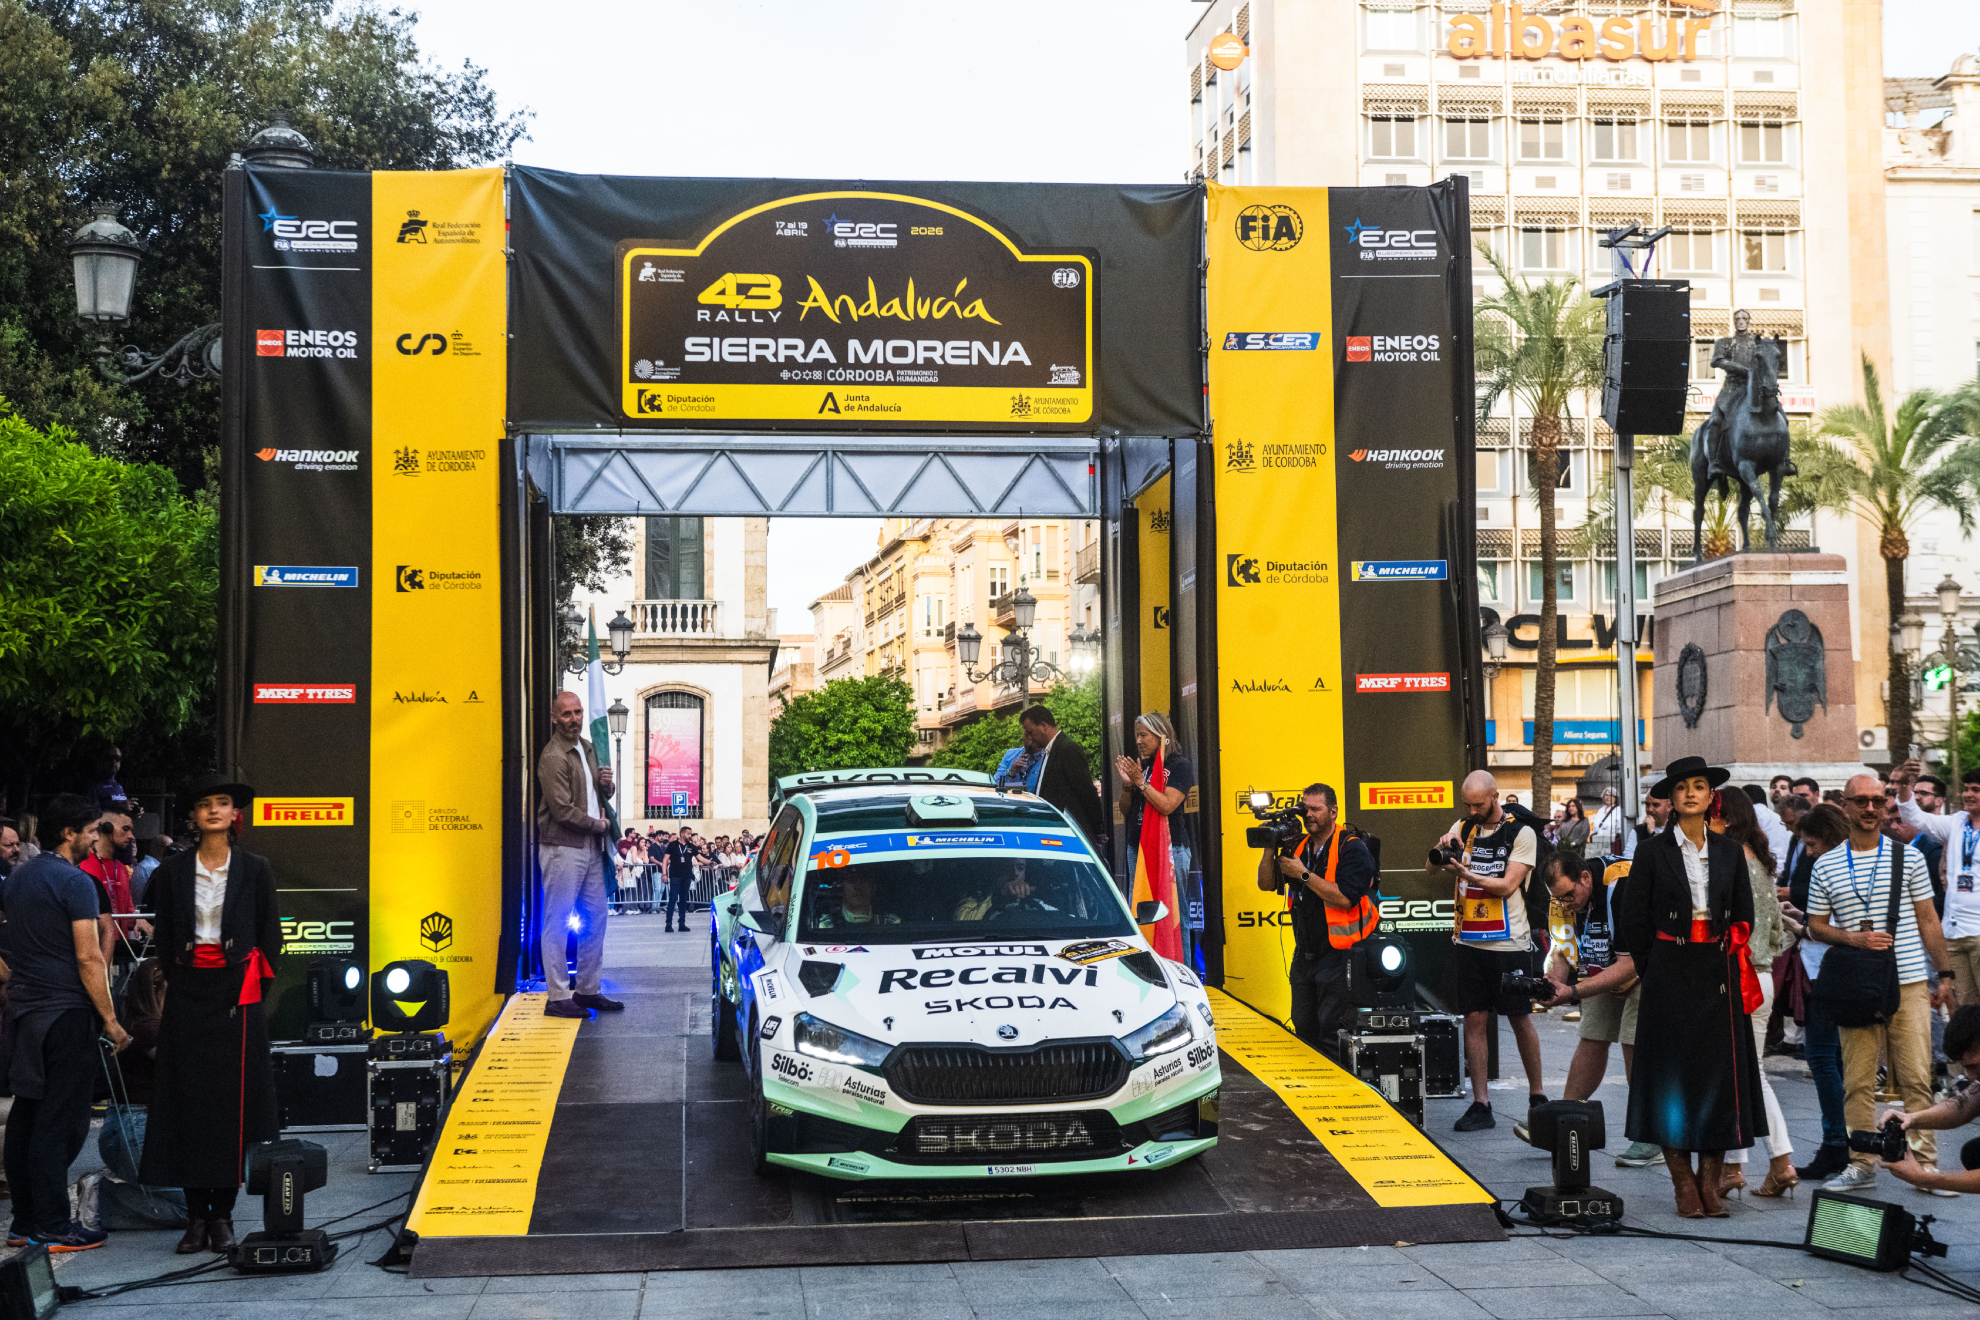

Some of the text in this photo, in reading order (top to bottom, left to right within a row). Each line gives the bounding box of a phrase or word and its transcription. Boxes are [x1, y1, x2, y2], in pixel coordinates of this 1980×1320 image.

[1447, 2, 1713, 60] albasur
[1513, 65, 1648, 86] inmobiliarias
[273, 220, 358, 239] ERC
[447, 221, 481, 229] Federación
[776, 221, 808, 230] 17 al 19
[834, 222, 898, 238] ERC
[1240, 215, 1297, 241] FIA
[438, 230, 466, 238] Española
[776, 229, 808, 237] ABRIL
[910, 227, 944, 236] 2026
[432, 237, 480, 245] Automovilismo
[1359, 230, 1437, 247] ERC
[1054, 271, 1078, 285] FIA
[698, 272, 783, 310] 43
[796, 276, 1003, 326] Andalucía
[697, 310, 782, 323] RALLY
[286, 330, 358, 346] ENEOS
[1373, 334, 1440, 350] ENEOS
[286, 347, 358, 359] MOTOR OIL
[684, 336, 1032, 367] SIERRA MORENA
[1374, 352, 1440, 362] MOTOR OIL
[826, 367, 895, 382] CÓRDOBA
[667, 394, 715, 404] Diputación
[844, 394, 870, 402] Junta
[1034, 397, 1078, 406] AYUNTAMIENTO
[667, 404, 716, 412] de Córdoba
[844, 403, 902, 412] de Andalucía
[1034, 407, 1042, 415] DE
[426, 450, 486, 460] AYUNTAMIENTO
[1262, 444, 1327, 456] AYUNTAMIENTO
[294, 462, 358, 472] driving emotion
[426, 461, 436, 472] DE
[1262, 456, 1273, 468] DE
[1385, 462, 1411, 470] driving
[1266, 560, 1328, 572] Diputación
[1378, 566, 1439, 575] MICHELIN
[283, 572, 349, 581] MICHELIN
[429, 570, 482, 580] Diputación
[1266, 573, 1329, 584] de Córdoba
[429, 581, 482, 590] de Córdoba
[1231, 678, 1293, 694] Andalucía
[1358, 676, 1448, 689] MRF TYRES
[256, 688, 353, 699] MRF TYRES
[392, 690, 449, 704] Andalucía
[1564, 731, 1608, 740] Allianz Seguros
[676, 795, 683, 804] P
[1368, 786, 1446, 805] PIRELLI
[263, 802, 345, 821] PIRELLI
[428, 823, 440, 831] DE
[810, 849, 851, 870] 10
[1237, 910, 1293, 928] SKO
[921, 946, 1043, 958] MOTUL
[878, 964, 1099, 994] Recalvi
[766, 978, 777, 1000] MICHELIN
[765, 1019, 779, 1030] UFI
[1153, 1057, 1182, 1080] Asturias
[1198, 1060, 1212, 1073] Telecom
[778, 1074, 800, 1088] Telecom
[844, 1075, 886, 1100] Asturias
[864, 1093, 886, 1106] natural
[839, 1160, 865, 1172] MICHELIN
[284, 1178, 292, 1198] BEAM
